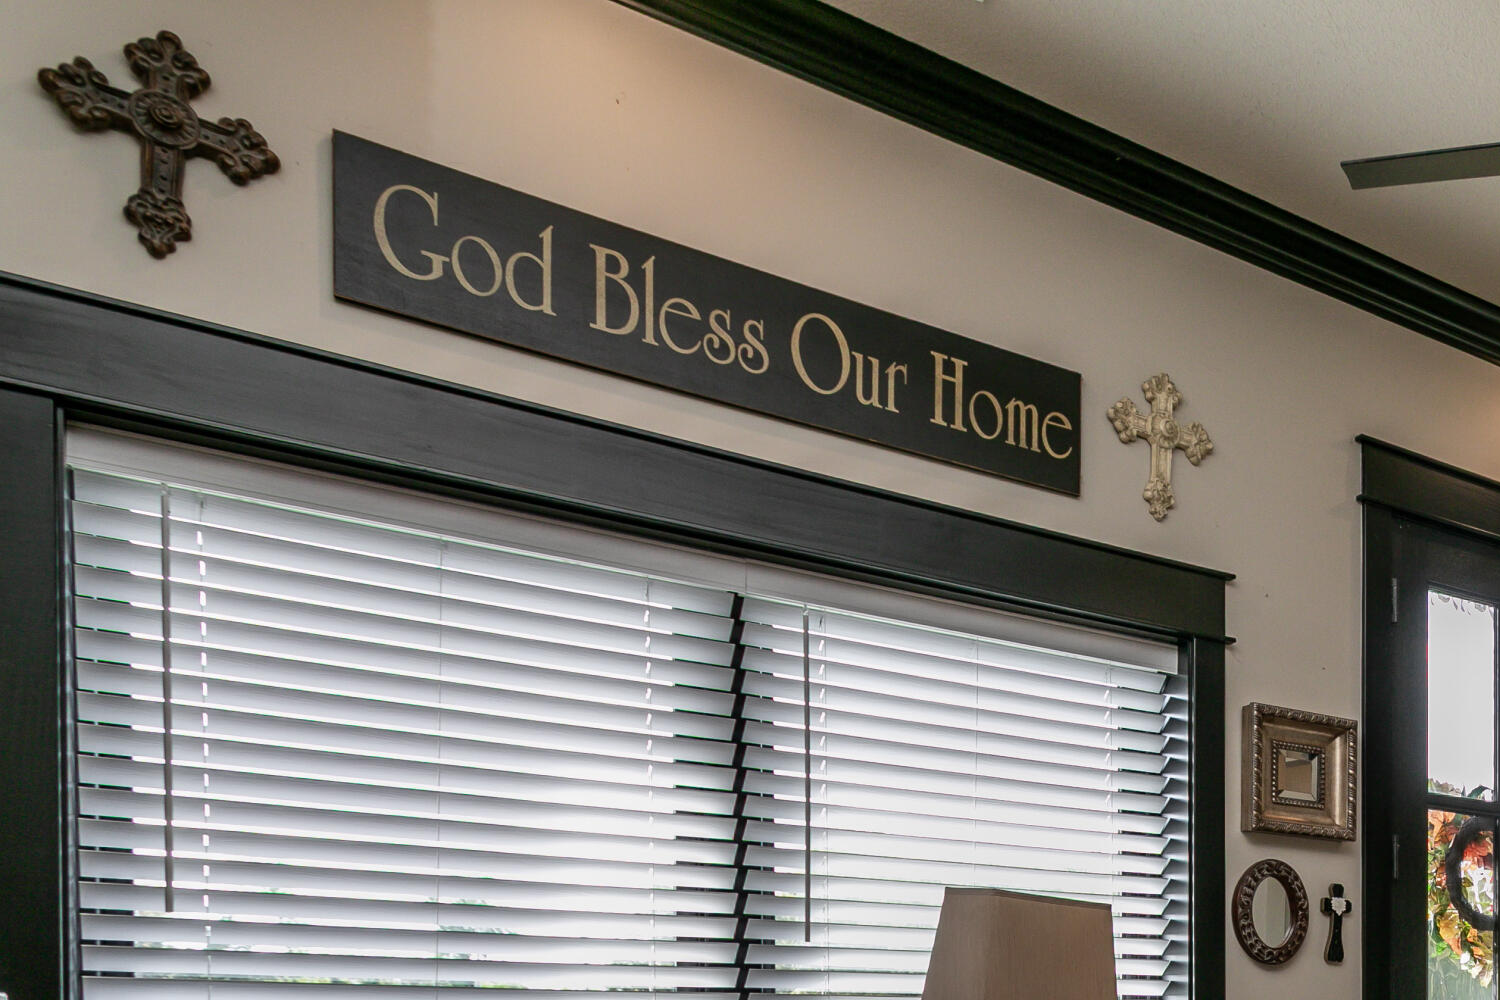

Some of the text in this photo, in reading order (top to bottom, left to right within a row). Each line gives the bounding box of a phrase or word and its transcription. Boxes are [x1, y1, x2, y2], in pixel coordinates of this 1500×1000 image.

[373, 184, 1073, 459] God Bless Our Home
